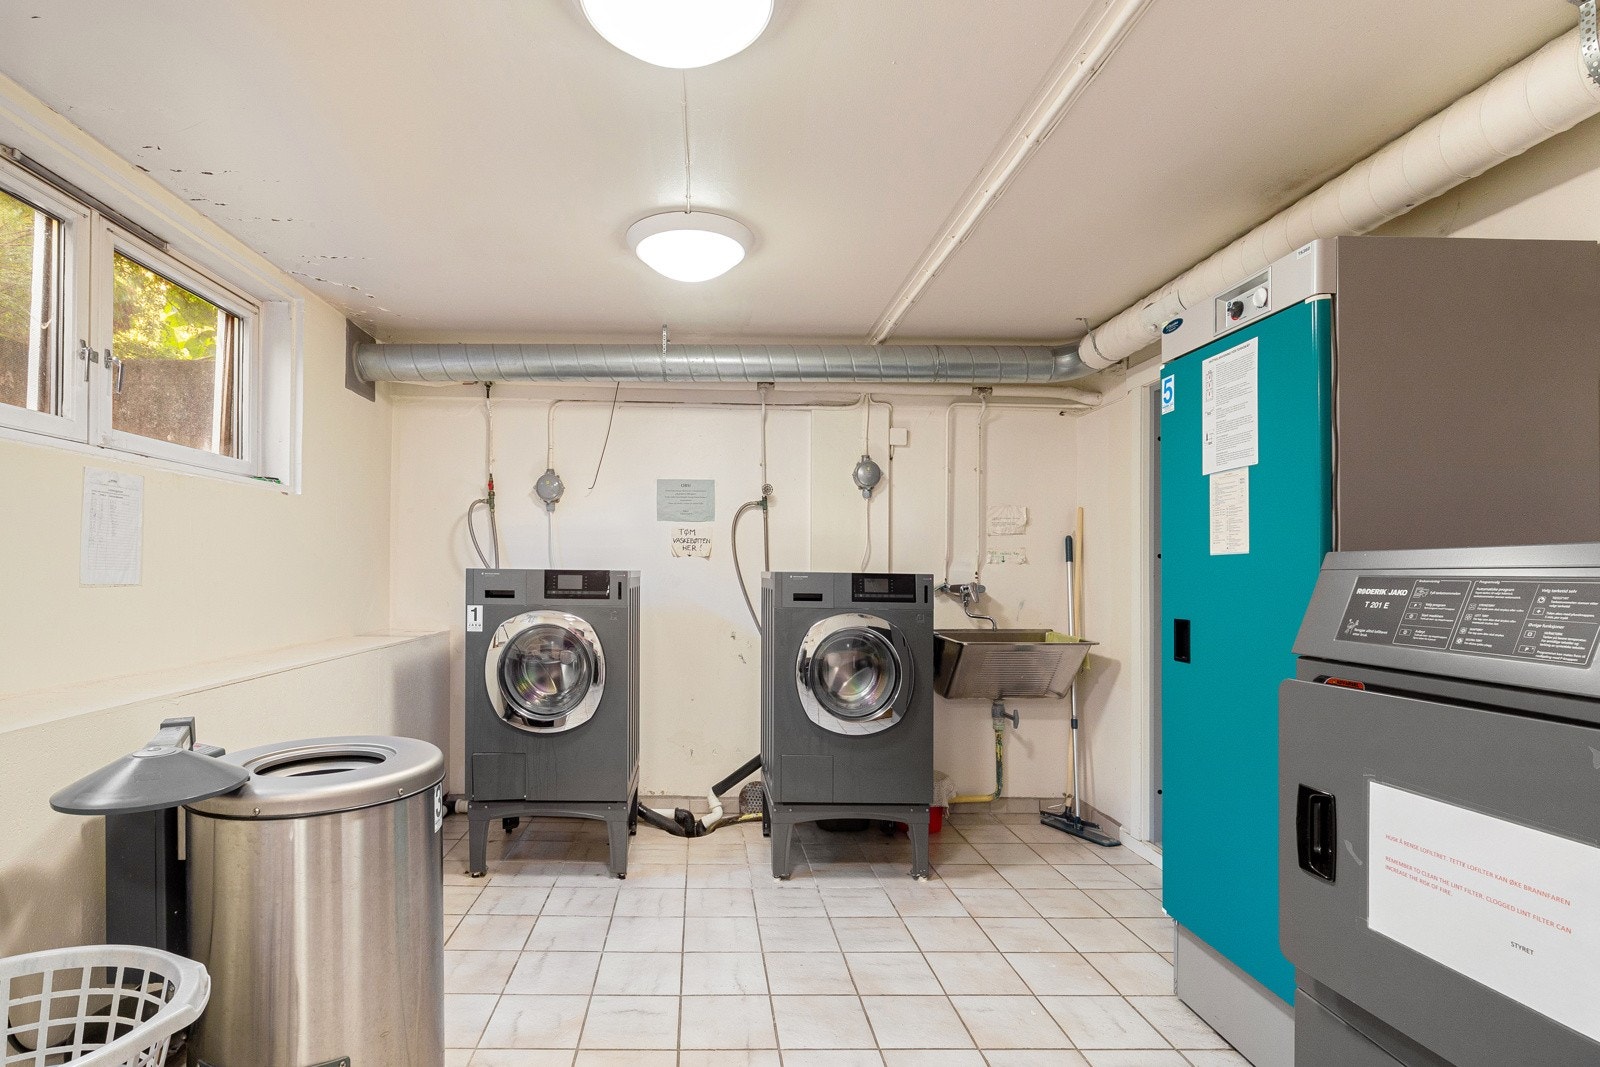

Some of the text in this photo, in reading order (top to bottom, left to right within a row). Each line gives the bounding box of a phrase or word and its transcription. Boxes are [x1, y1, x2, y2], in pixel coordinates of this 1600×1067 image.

[1163, 377, 1173, 404] 5
[471, 607, 478, 621] 1
[436, 784, 441, 817] 3
[1385, 864, 1408, 877] INCREASE
[1409, 874, 1418, 882] THE
[1420, 879, 1430, 887] RISK
[1386, 834, 1398, 842] HUSK
[1404, 841, 1419, 851] RENSE
[1449, 857, 1465, 867] TETTE
[1467, 864, 1493, 877] LOFILTER
[1495, 874, 1507, 883] KAN
[1509, 879, 1522, 888] ØKE
[1524, 884, 1570, 906] BRANNFAREN
[1386, 856, 1412, 871] REMEMBER
[1422, 871, 1438, 881] CLEAN
[1440, 878, 1449, 886] THE
[1451, 882, 1463, 890] LINT
[1486, 896, 1515, 912] CLOGGED
[1517, 908, 1531, 917] LINT
[1532, 914, 1554, 927] FILTER
[1556, 924, 1572, 934] CAN
[1510, 941, 1534, 955] STYRET
